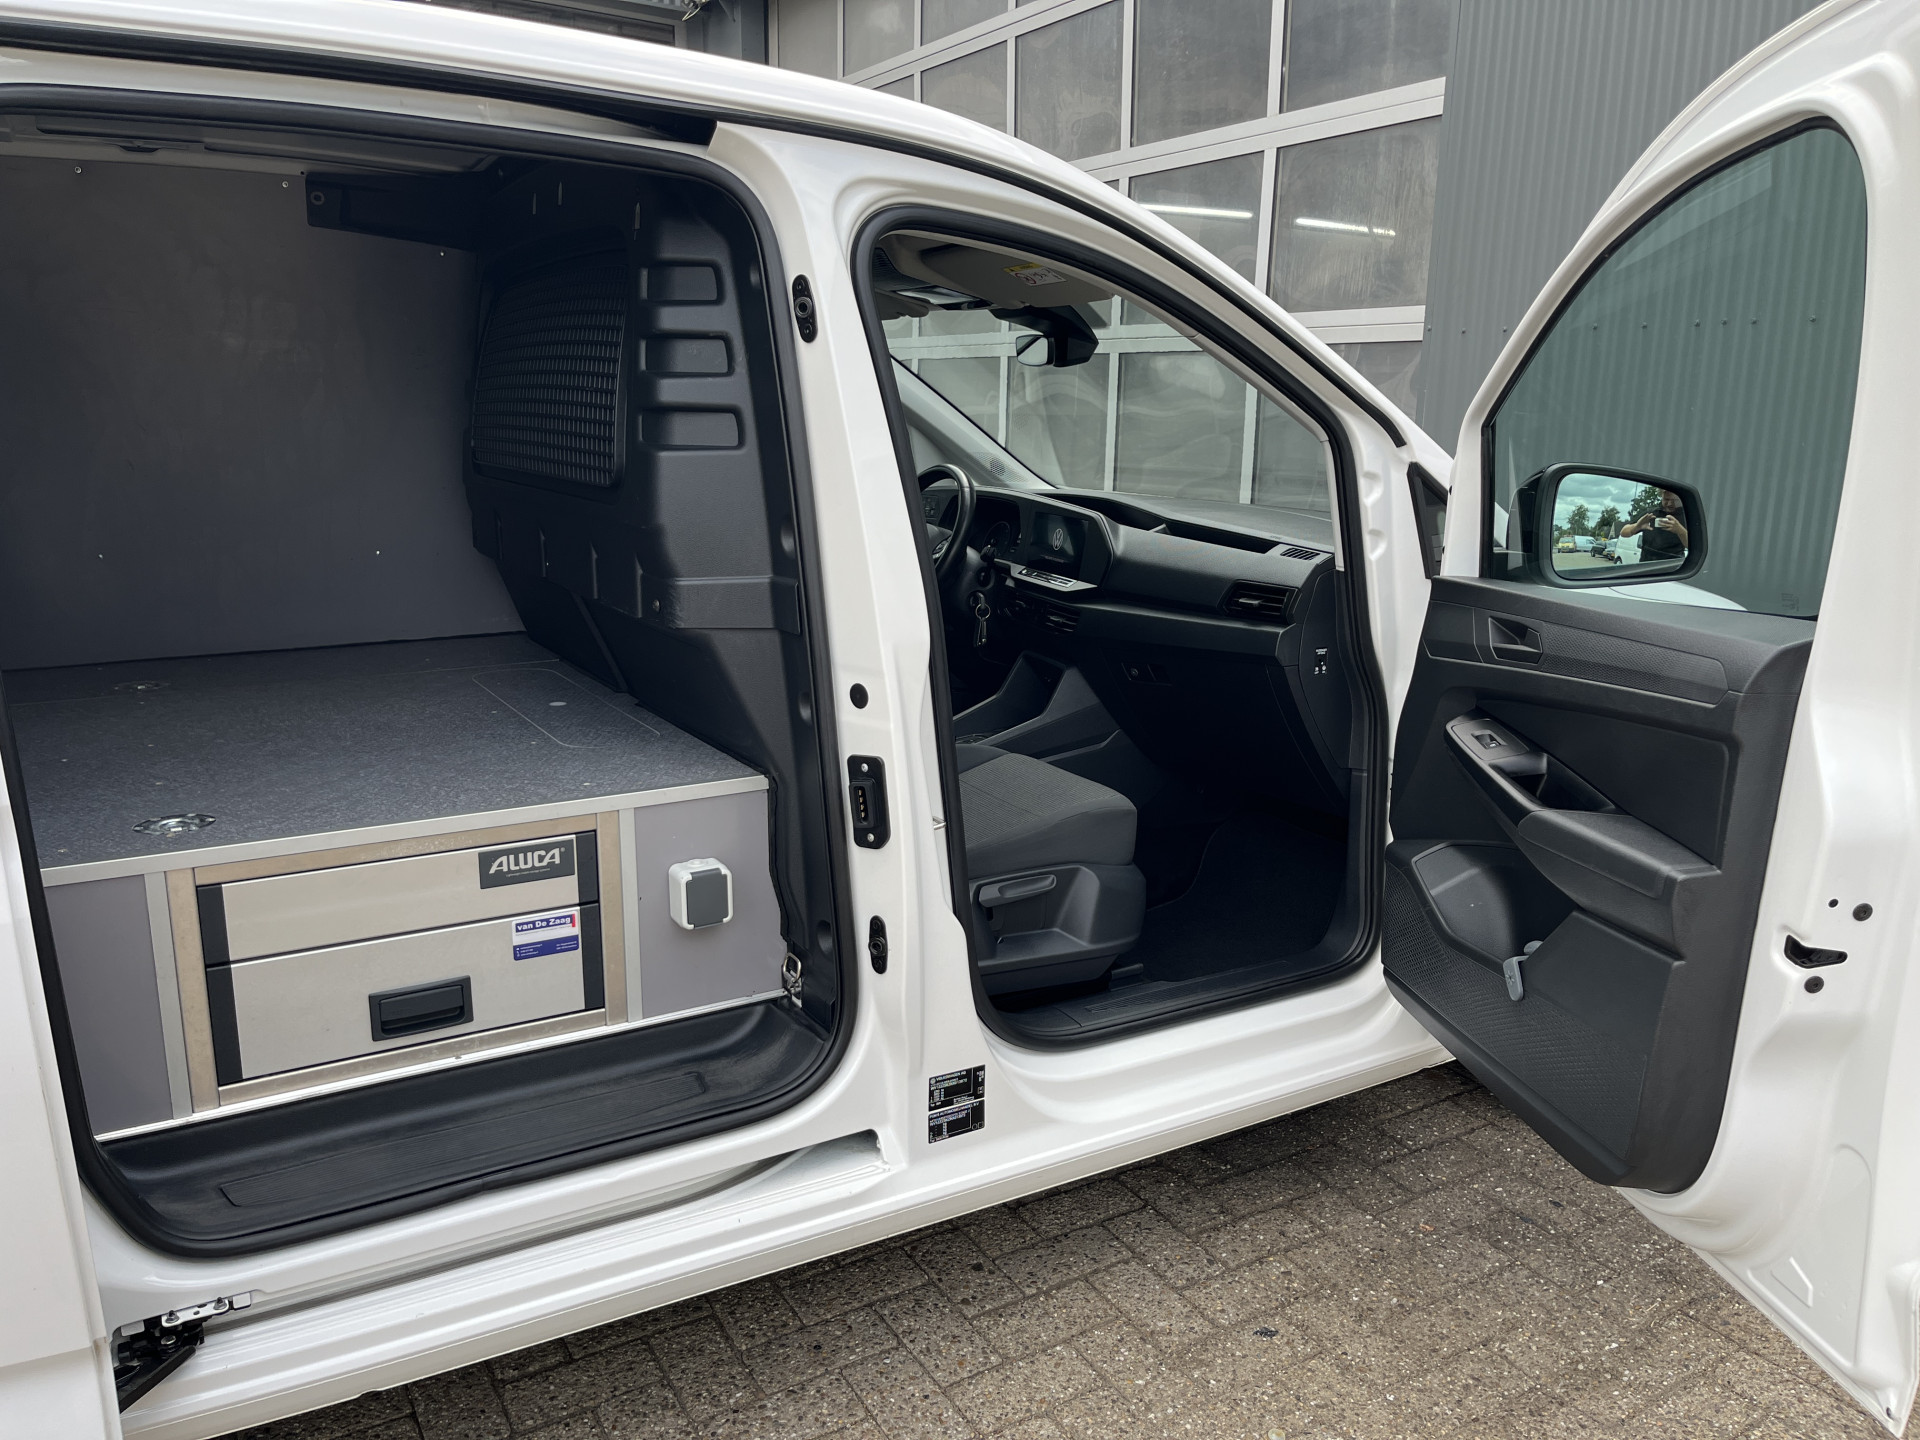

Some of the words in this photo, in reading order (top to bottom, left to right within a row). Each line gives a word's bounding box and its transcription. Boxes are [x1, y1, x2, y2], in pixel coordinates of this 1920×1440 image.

[489, 848, 560, 874] ALUCA
[517, 923, 533, 931] van
[535, 920, 547, 928] De
[549, 917, 571, 926] Zaag
